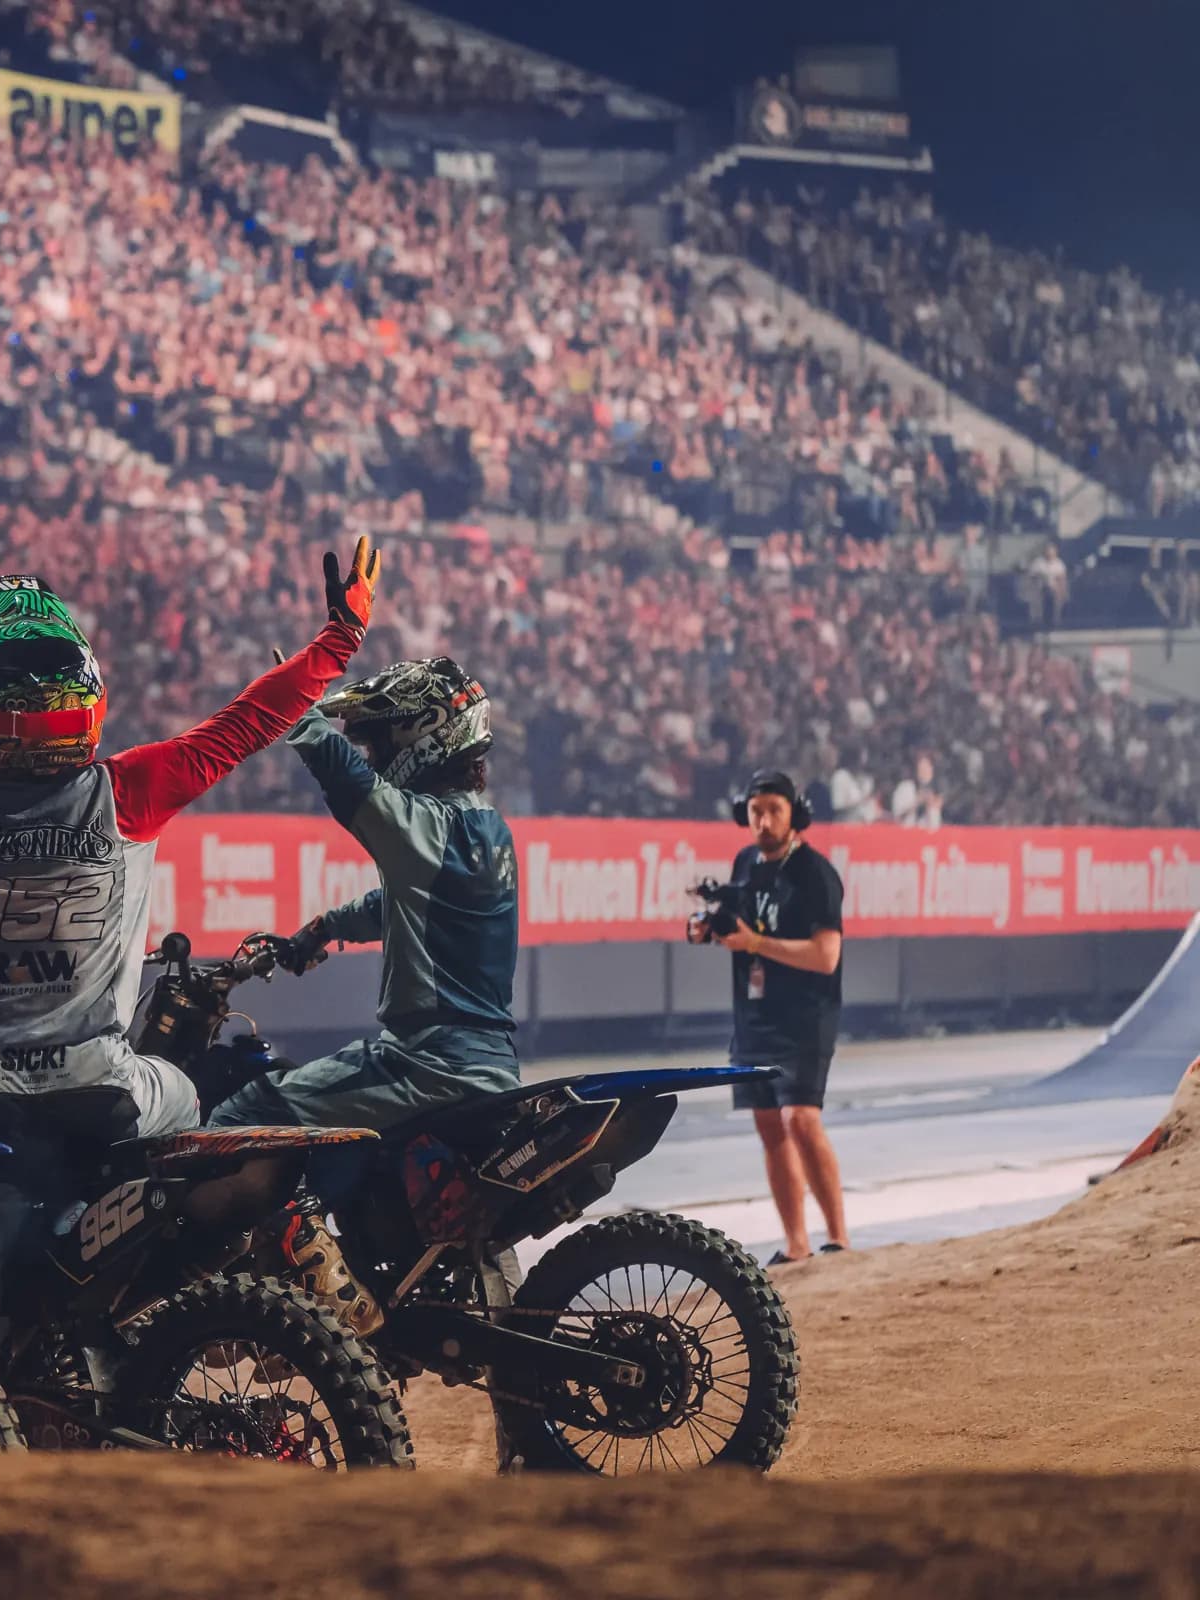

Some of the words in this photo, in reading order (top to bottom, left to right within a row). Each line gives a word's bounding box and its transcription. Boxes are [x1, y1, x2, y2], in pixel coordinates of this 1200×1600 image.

[527, 842, 638, 922] Kronen
[1, 1045, 67, 1073] SICK!
[80, 1177, 146, 1262] 952
